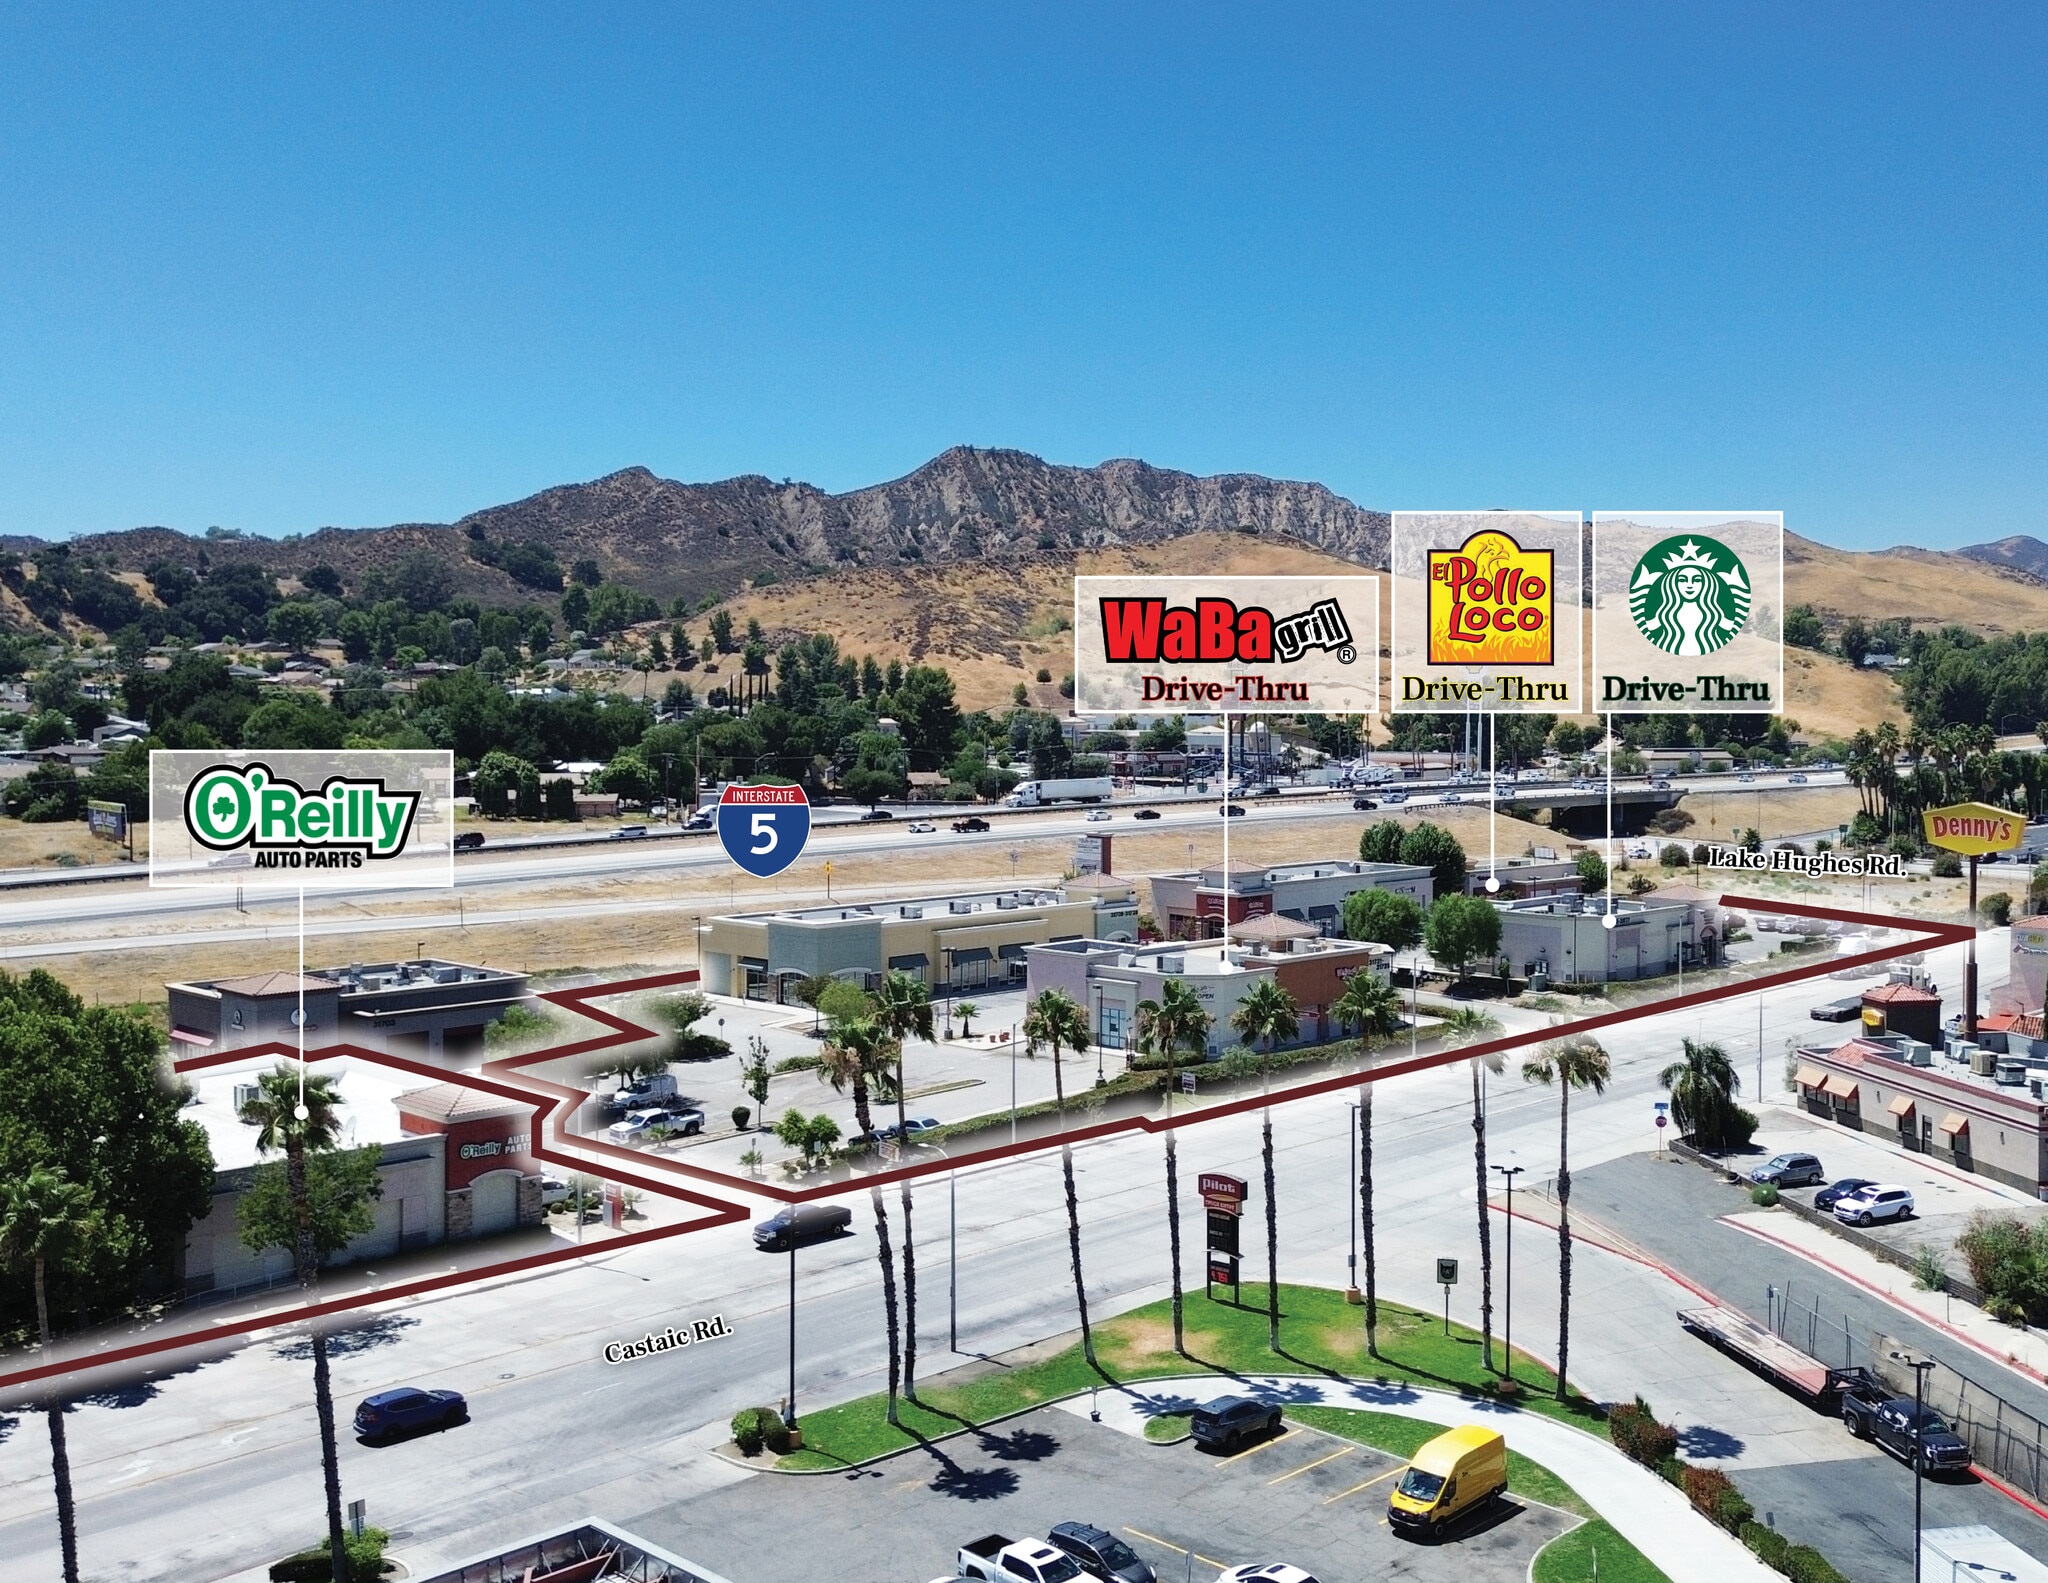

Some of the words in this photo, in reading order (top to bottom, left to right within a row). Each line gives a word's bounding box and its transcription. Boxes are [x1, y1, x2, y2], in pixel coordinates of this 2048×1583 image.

[1932, 815, 2011, 841] Denny's
[460, 1141, 502, 1159] O'Reilly
[1202, 1178, 1236, 1193] Pilot
